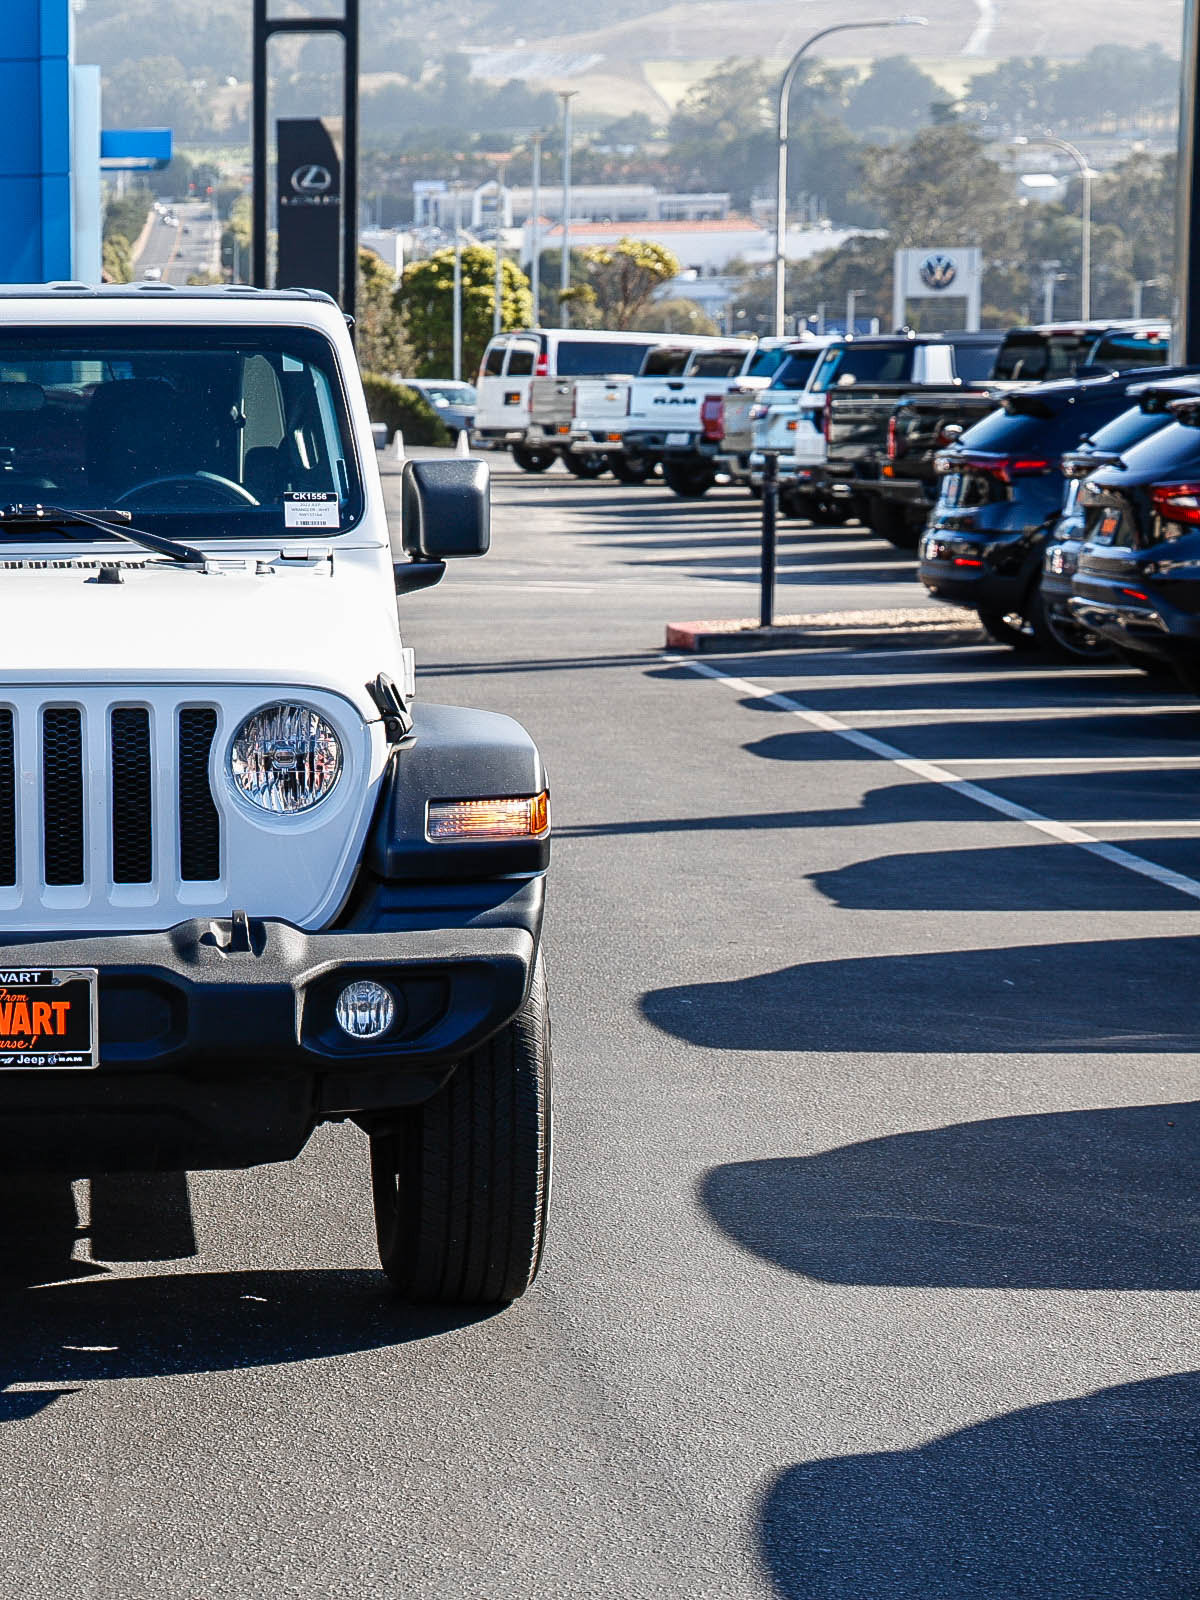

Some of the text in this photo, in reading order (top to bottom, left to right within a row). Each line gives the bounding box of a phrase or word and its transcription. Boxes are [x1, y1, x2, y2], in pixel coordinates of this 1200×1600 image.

[653, 396, 697, 406] RAM
[292, 492, 327, 500] CK1556
[16, 1055, 45, 1066] Jeep
